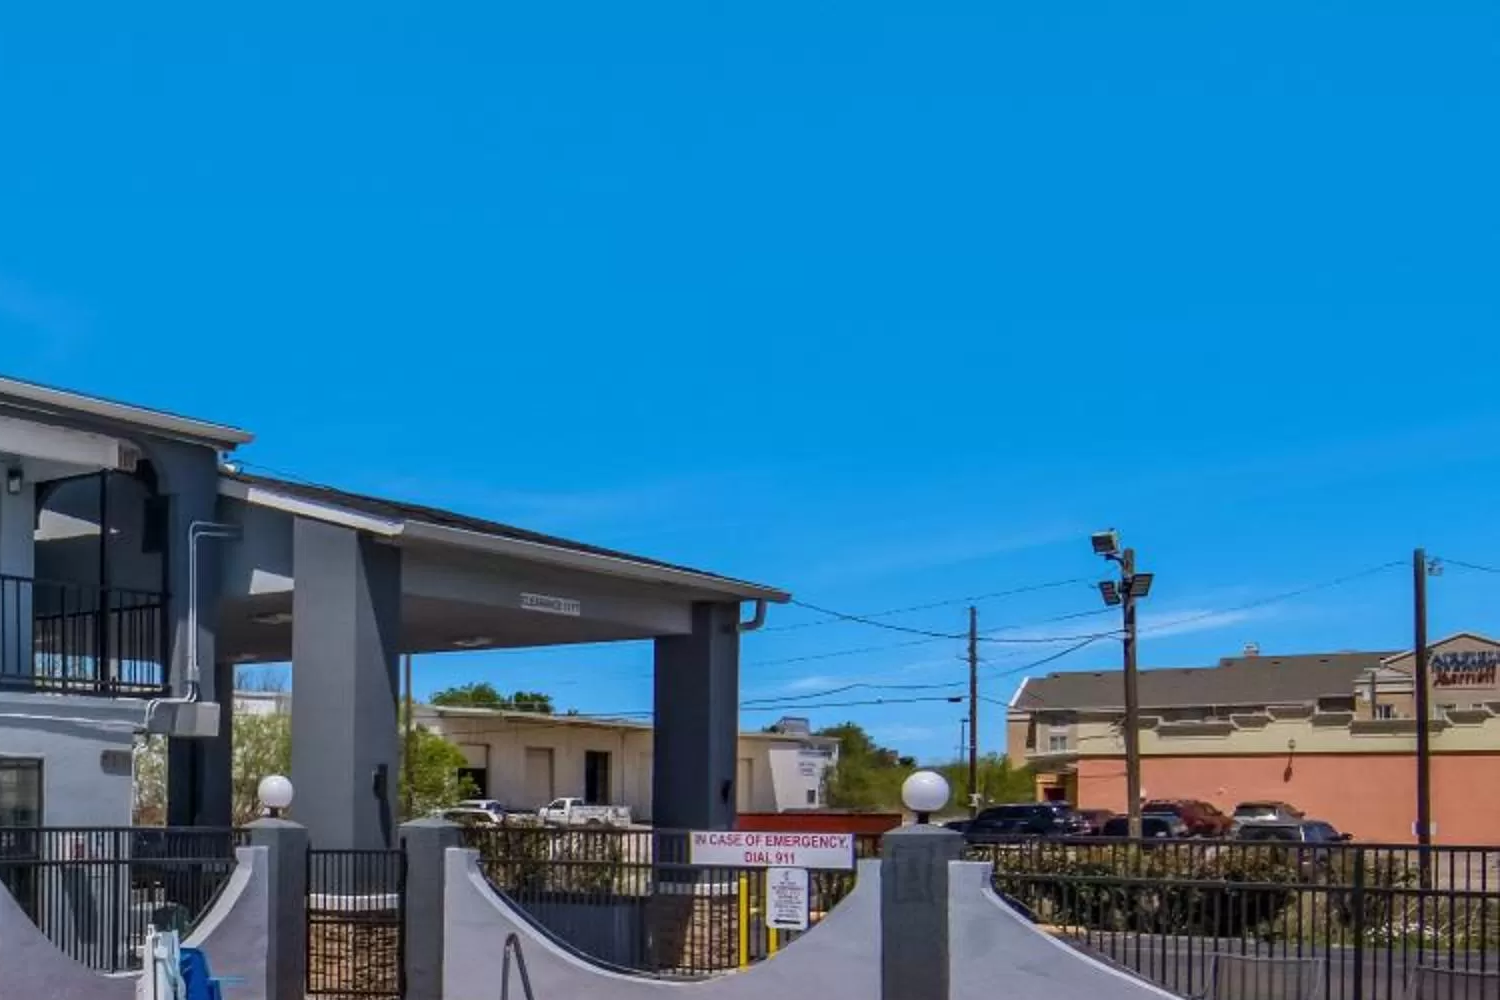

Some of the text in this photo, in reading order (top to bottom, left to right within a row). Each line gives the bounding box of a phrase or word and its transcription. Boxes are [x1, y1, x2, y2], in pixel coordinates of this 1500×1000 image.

[694, 833, 707, 846] IN
[709, 833, 743, 847] CASE
[745, 833, 762, 847] OF
[744, 851, 796, 865] DIAL 911
